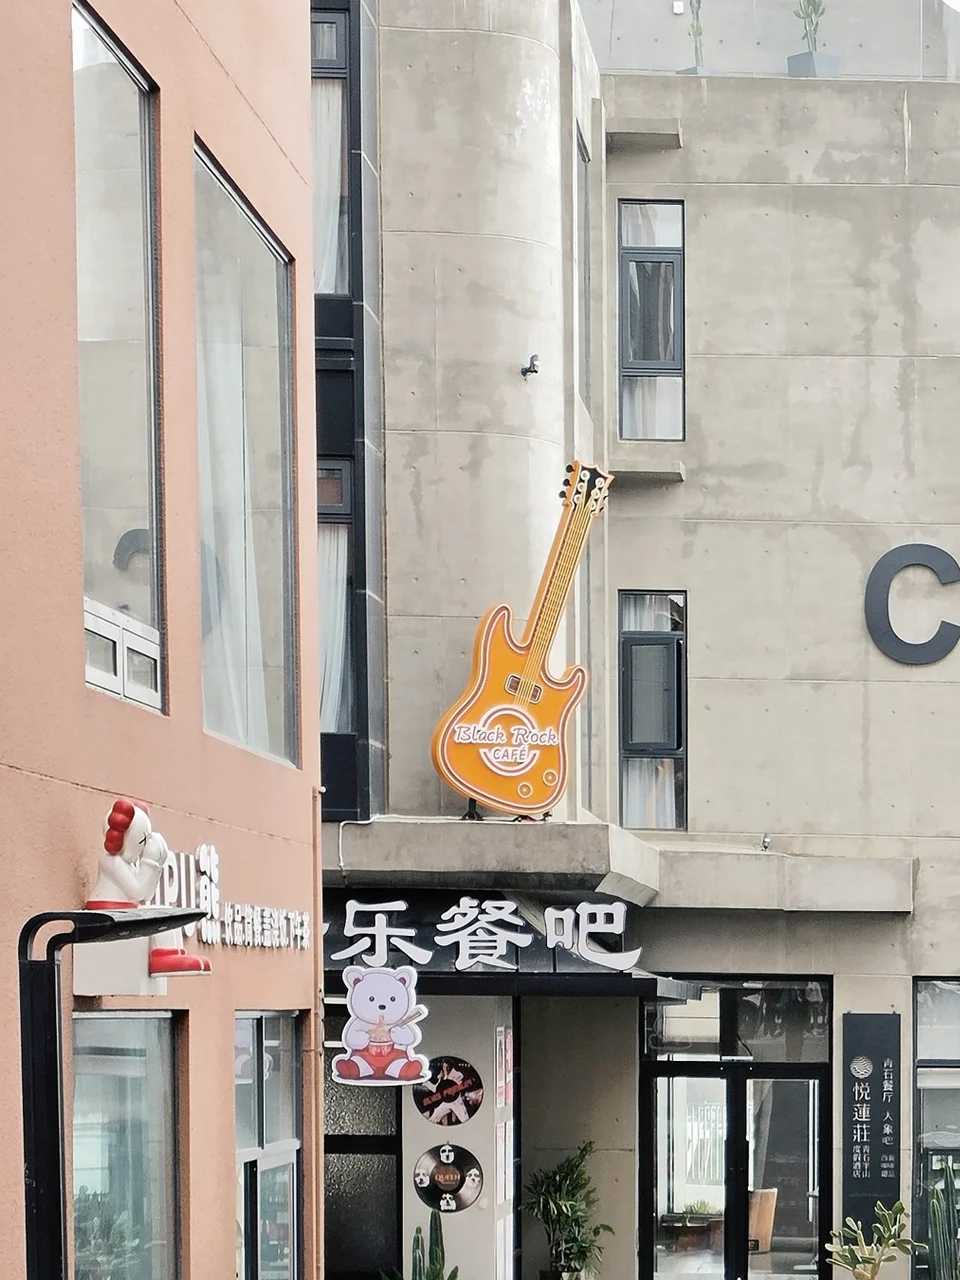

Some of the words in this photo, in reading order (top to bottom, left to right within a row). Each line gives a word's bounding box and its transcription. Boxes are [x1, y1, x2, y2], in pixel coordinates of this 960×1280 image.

[456, 725, 506, 743] Black
[511, 726, 558, 745] Rock
[493, 745, 528, 761] CAFÉ
[322, 896, 643, 971] 乐餐吧
